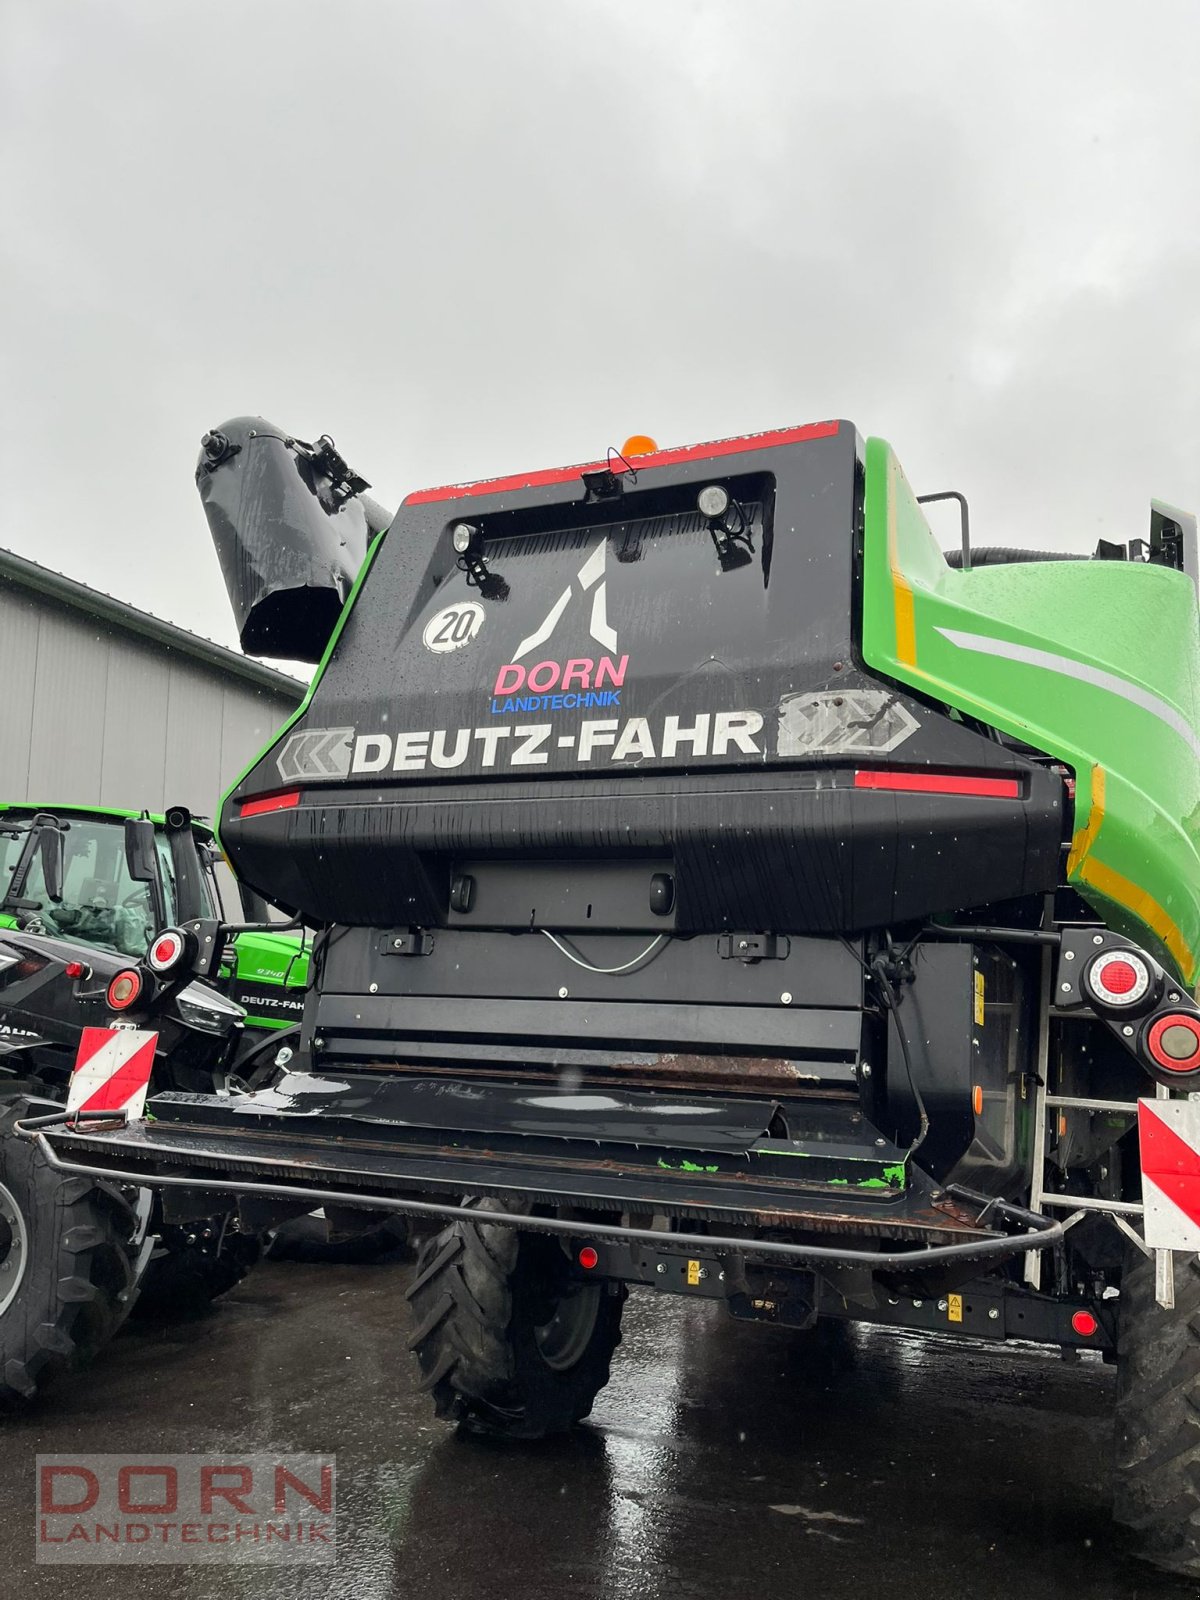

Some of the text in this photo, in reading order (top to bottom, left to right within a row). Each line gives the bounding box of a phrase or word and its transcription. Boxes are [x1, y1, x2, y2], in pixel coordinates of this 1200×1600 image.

[432, 611, 475, 644] 20
[493, 654, 629, 696] DORN
[491, 690, 621, 714] LANDTECHNIK
[351, 710, 764, 774] DEUTZ-FAHR
